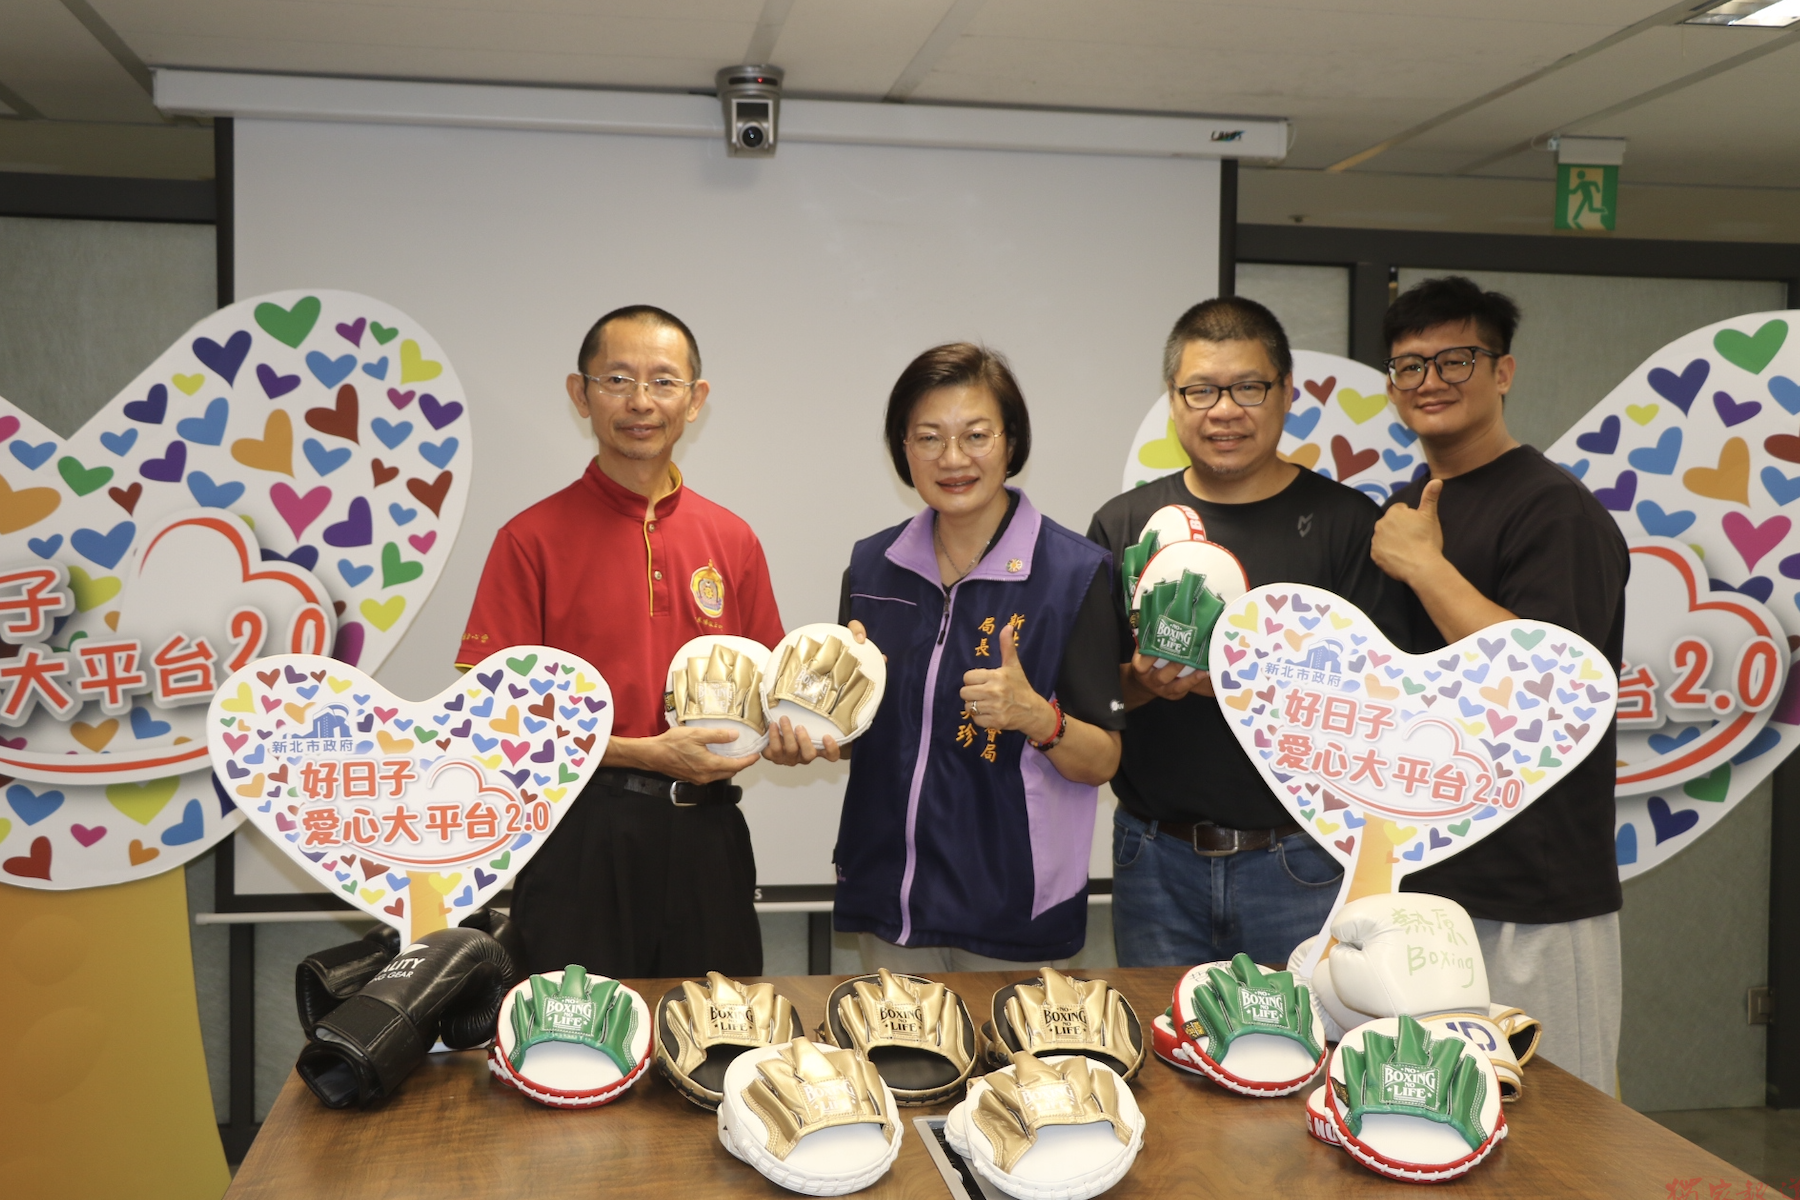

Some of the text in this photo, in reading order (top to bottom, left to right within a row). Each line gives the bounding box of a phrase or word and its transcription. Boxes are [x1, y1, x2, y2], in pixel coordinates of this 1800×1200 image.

[0, 569, 62, 633] 子
[975, 617, 995, 656] 局長
[1157, 620, 1192, 646] BOXING
[1160, 638, 1181, 651] LIFE
[0, 607, 327, 716] 大平台20
[1265, 662, 1342, 687] 新北市政府
[1284, 688, 1394, 739] 好日子
[272, 740, 353, 753] 新北市政府
[300, 760, 416, 799] 好日子
[1275, 734, 1523, 809] 愛心大平台2.0
[302, 801, 549, 847] 愛心大平台2.0
[387, 971, 414, 979] GEAR
[1407, 944, 1474, 988] Boxing
[546, 1000, 592, 1019] BOXING
[1241, 990, 1284, 1012] BOXING
[553, 1014, 582, 1026] LIFE
[710, 1006, 754, 1023] BOXING
[880, 1006, 922, 1022] BOXING
[1044, 1009, 1087, 1024] BOXING
[1252, 1007, 1279, 1019] LIFE
[721, 1022, 747, 1031] LIFE
[891, 1021, 918, 1032] LIFE
[1055, 1025, 1082, 1035] LIFE
[1385, 1067, 1436, 1090] BOXING
[803, 1081, 856, 1102] BOXING
[1021, 1084, 1075, 1105] BOXING
[1393, 1084, 1426, 1098] LIFE
